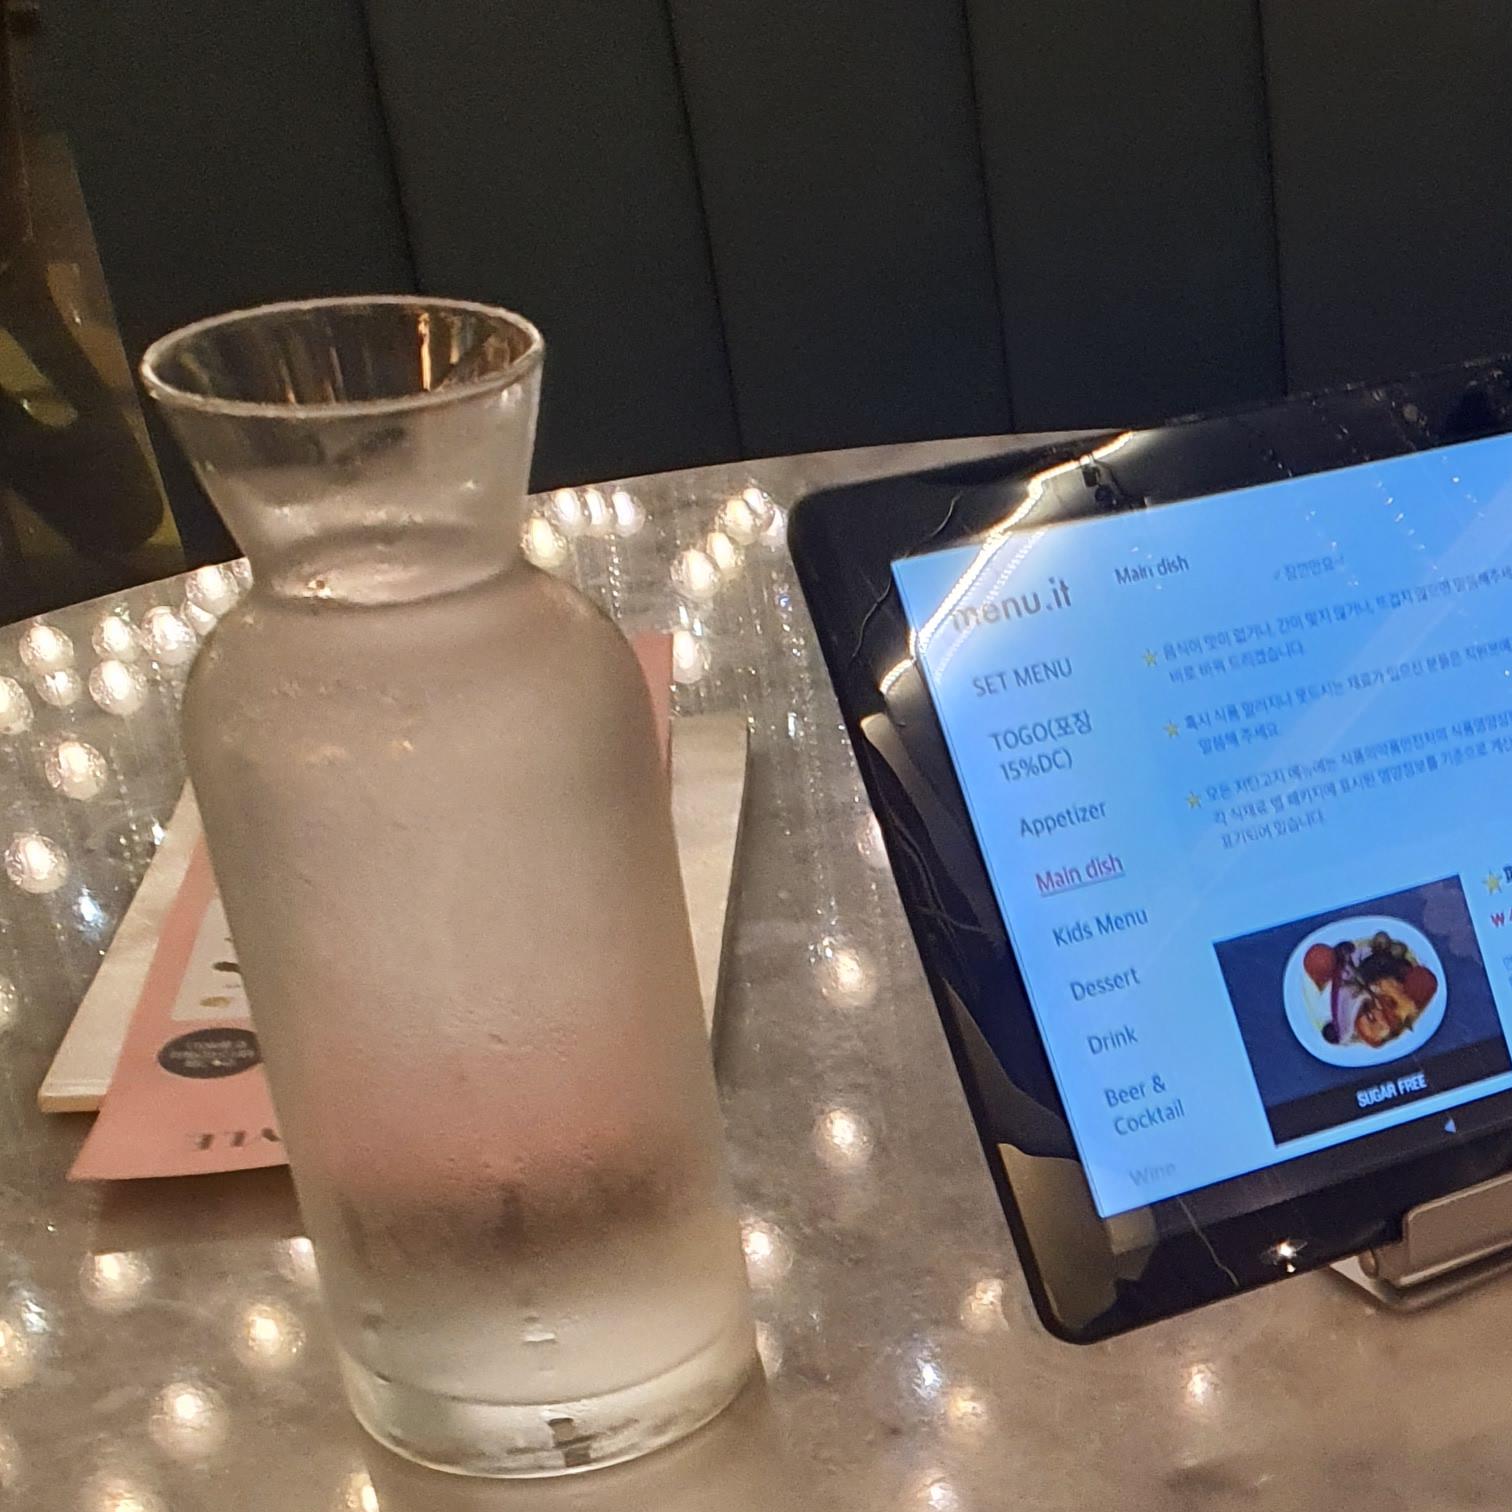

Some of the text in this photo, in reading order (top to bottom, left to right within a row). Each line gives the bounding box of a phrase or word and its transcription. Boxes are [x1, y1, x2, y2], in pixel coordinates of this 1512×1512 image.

[1113, 554, 1189, 584] Main dish
[952, 577, 1073, 633] menu.it
[971, 657, 1072, 697] SET MENU
[989, 709, 1091, 750] TOGO(포장
[1000, 747, 1072, 780] 15%DC)
[1020, 802, 1105, 836] Appetizer
[1034, 850, 1125, 893] Main dish
[1052, 909, 1147, 946] Kids Menu
[1069, 967, 1140, 1000] Dessert
[1086, 1025, 1137, 1054] Drink
[1103, 1073, 1165, 1107] Beer &
[1356, 1070, 1426, 1106] SUGAR FREE
[1113, 1098, 1184, 1135] Cocktail
[1127, 1162, 1175, 1186] Wine
